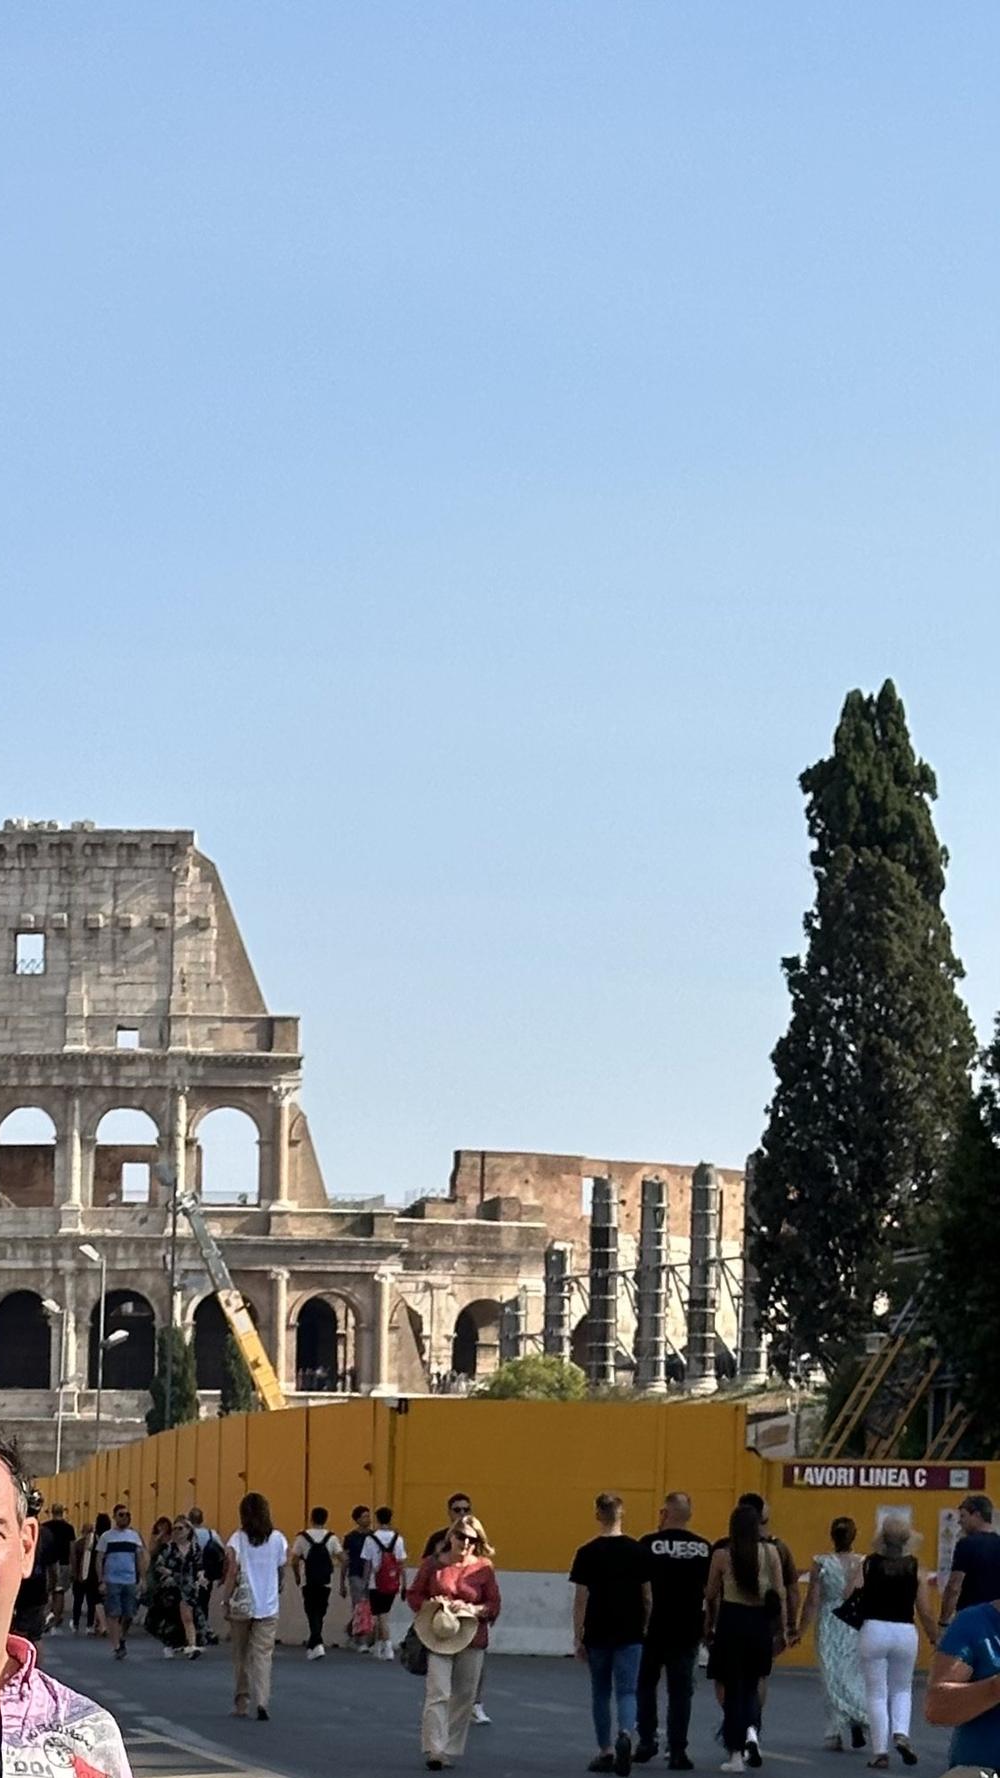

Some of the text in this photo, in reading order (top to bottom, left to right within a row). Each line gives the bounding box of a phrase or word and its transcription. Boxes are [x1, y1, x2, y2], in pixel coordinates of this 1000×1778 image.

[793, 1466, 928, 1487] LAVORI LINEA C
[651, 1540, 709, 1557] GUESS
